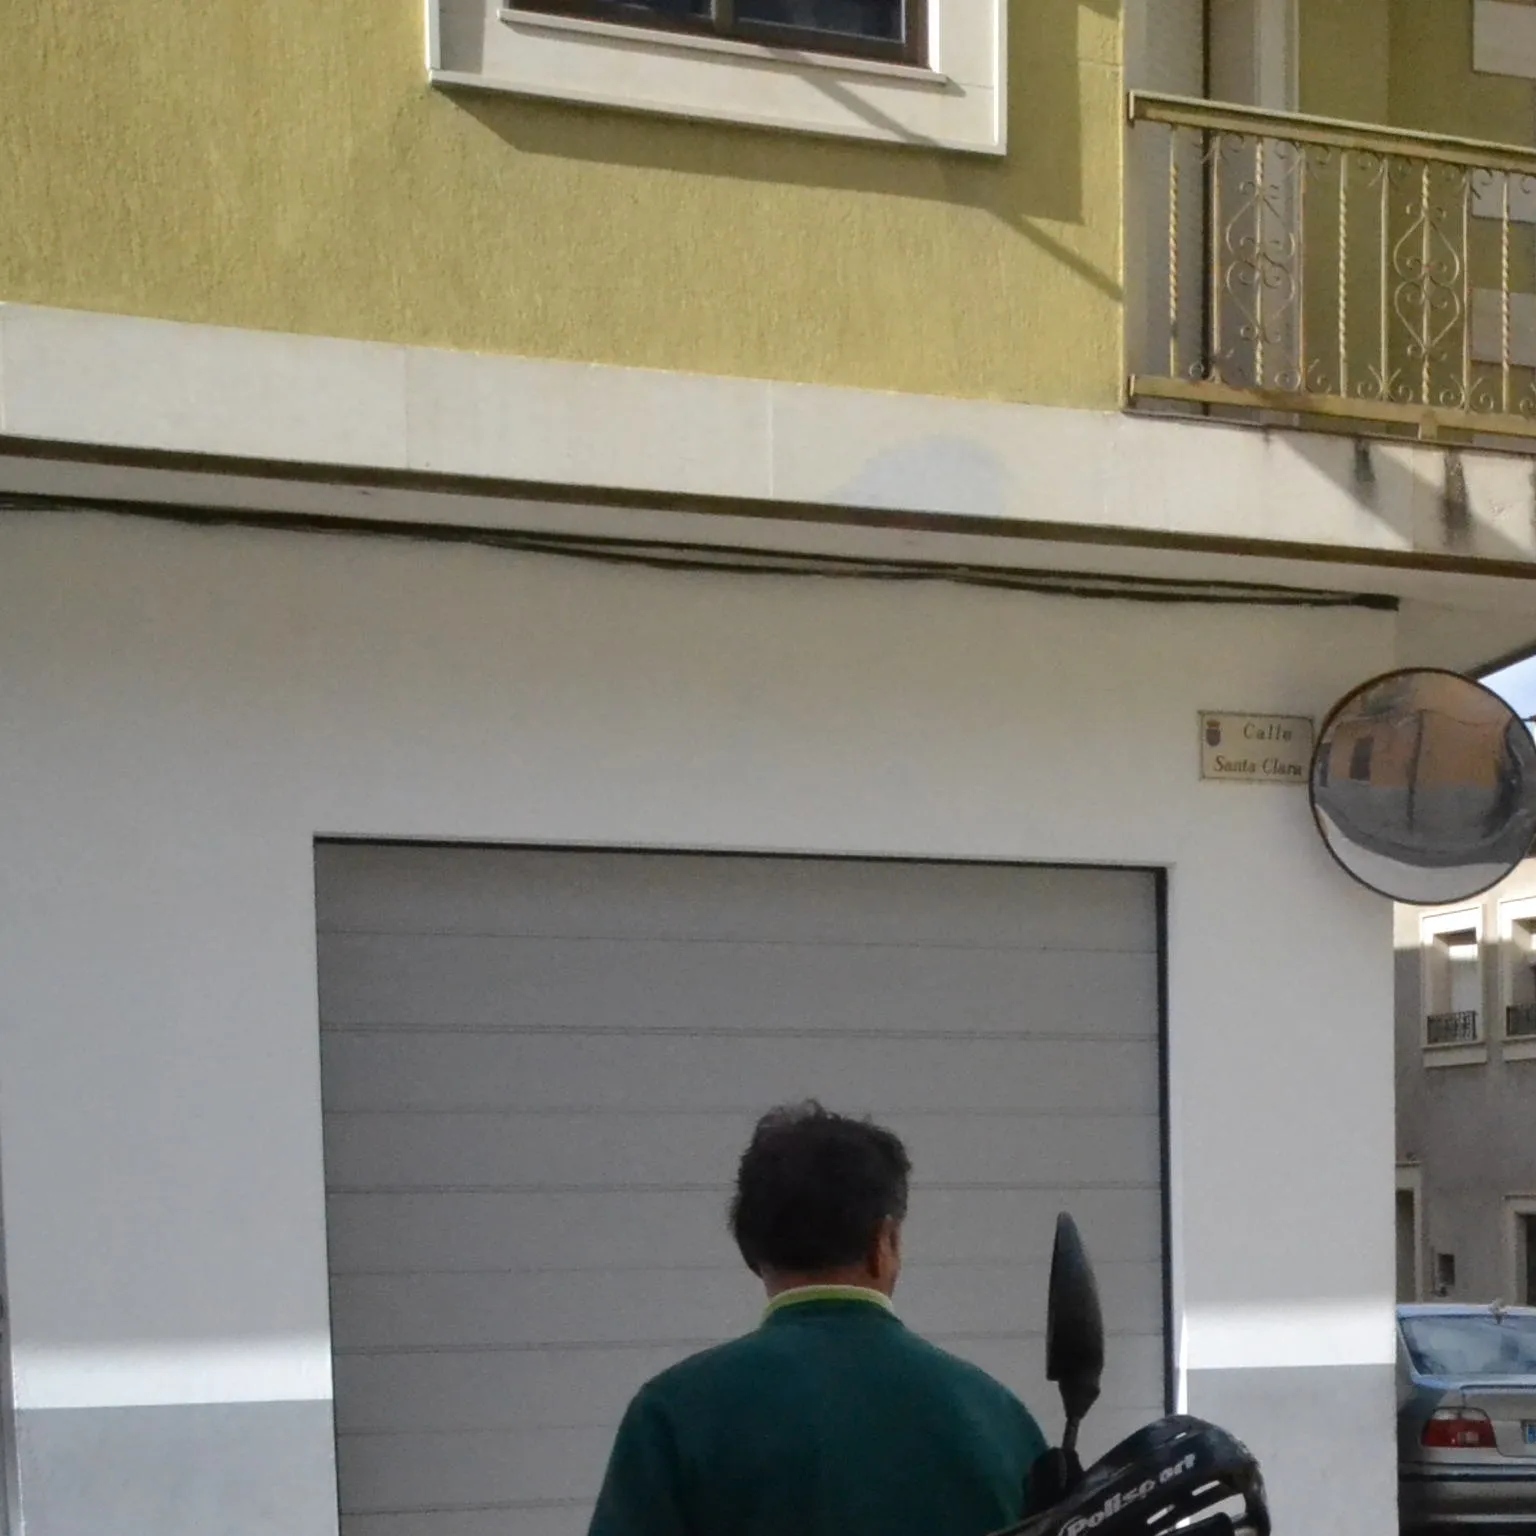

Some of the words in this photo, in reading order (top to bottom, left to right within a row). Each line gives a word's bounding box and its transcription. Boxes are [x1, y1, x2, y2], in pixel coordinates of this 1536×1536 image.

[1243, 722, 1293, 742] Calle
[1214, 754, 1256, 774] Santa
[1262, 757, 1303, 777] Clara
